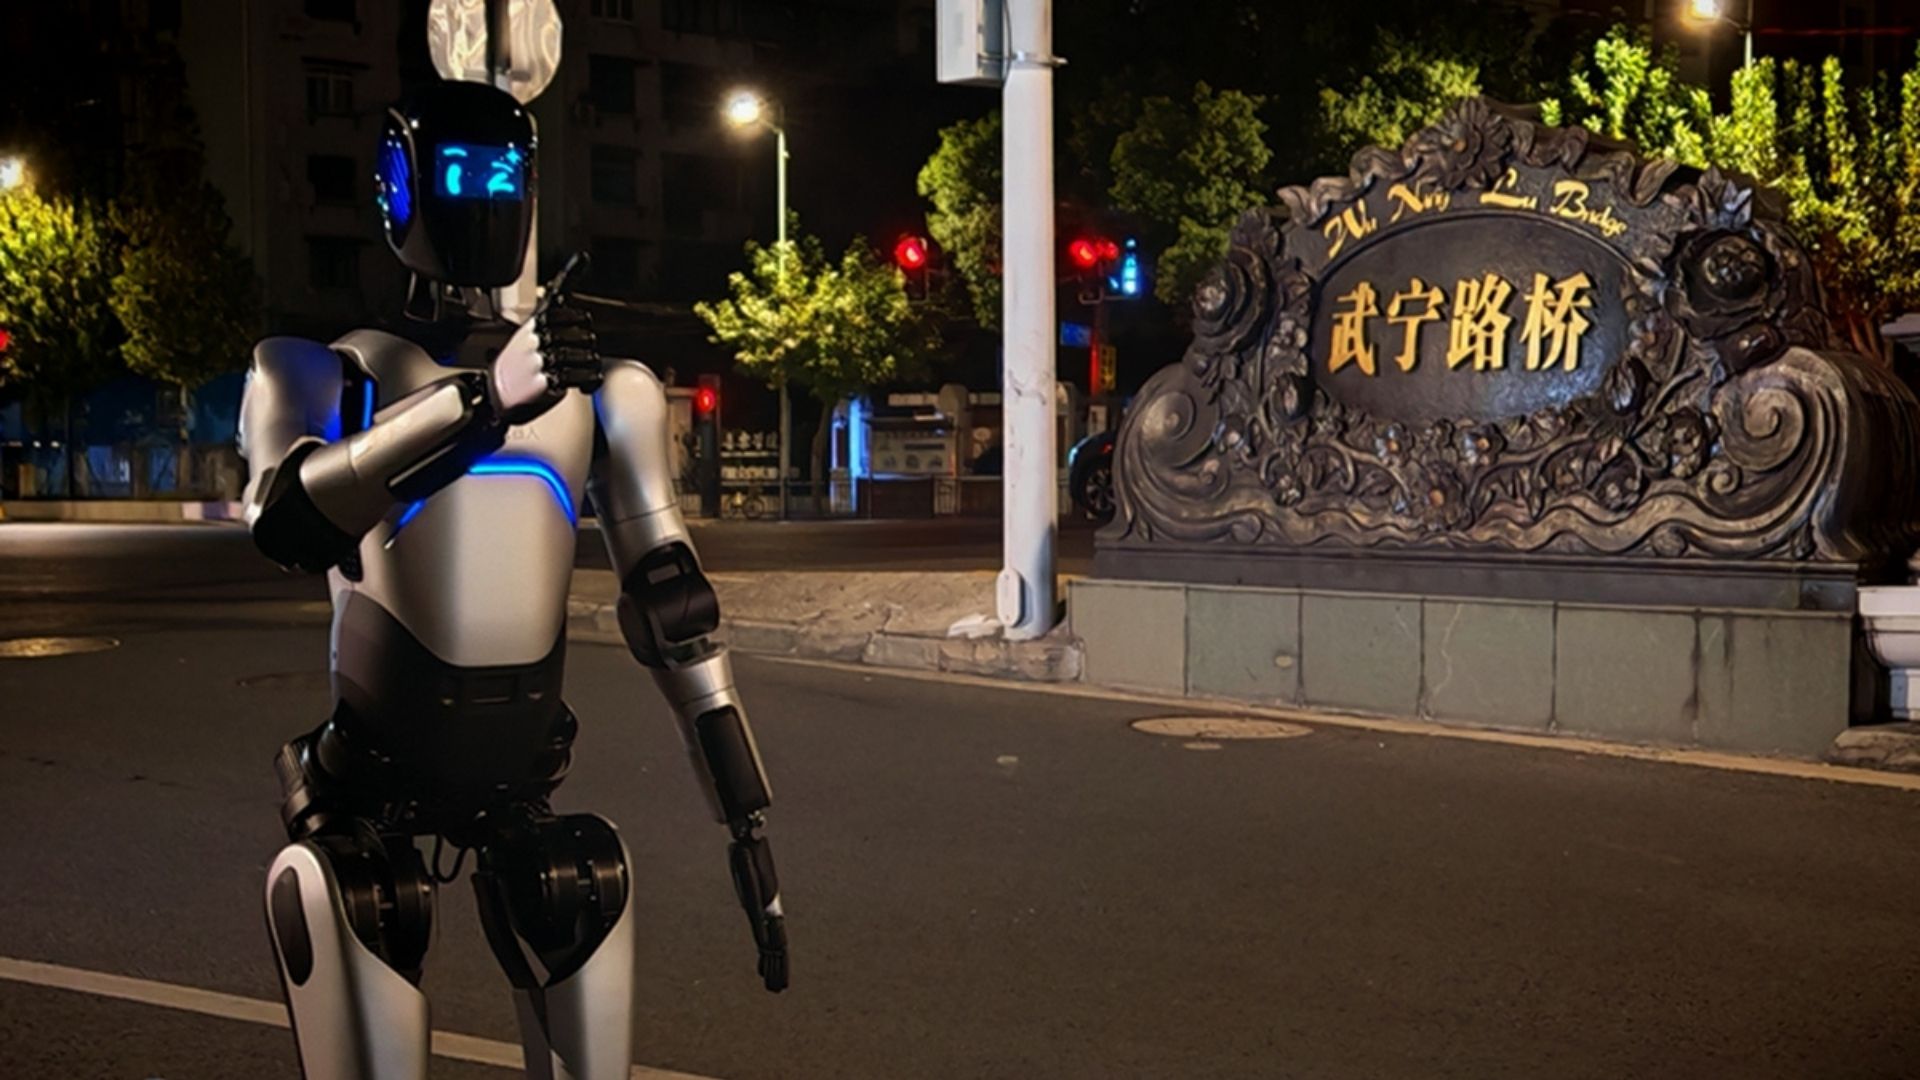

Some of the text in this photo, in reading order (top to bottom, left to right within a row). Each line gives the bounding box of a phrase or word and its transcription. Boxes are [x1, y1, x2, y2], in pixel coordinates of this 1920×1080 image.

[1479, 166, 1538, 210] Lu
[1549, 179, 1628, 237] Bridge
[1328, 271, 1592, 377] 武宁路桥
